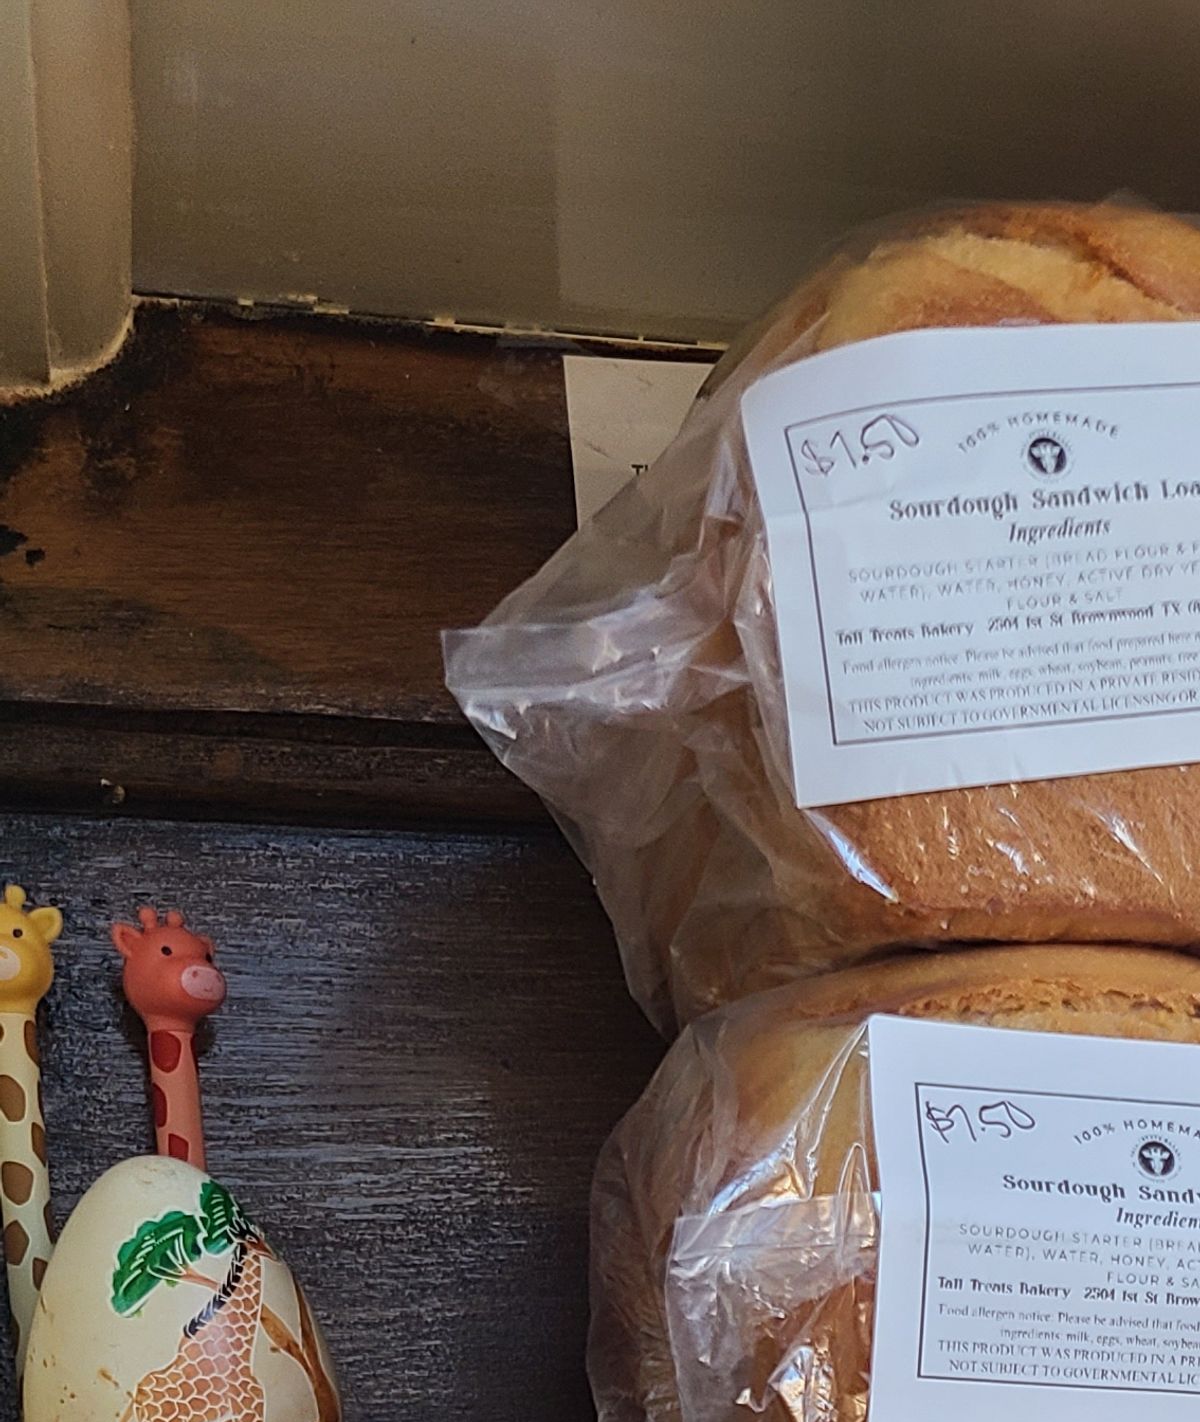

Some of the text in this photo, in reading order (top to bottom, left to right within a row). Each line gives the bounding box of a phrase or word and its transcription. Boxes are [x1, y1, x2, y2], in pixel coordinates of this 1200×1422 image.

[1007, 412, 1120, 438] HOMEMADE
[888, 491, 1018, 520] Sourdough
[1031, 480, 1149, 509] Sandwich
[1008, 515, 1110, 546] Ingredients
[1072, 1122, 1115, 1145] 100%
[1002, 1173, 1126, 1203] Sourdough
